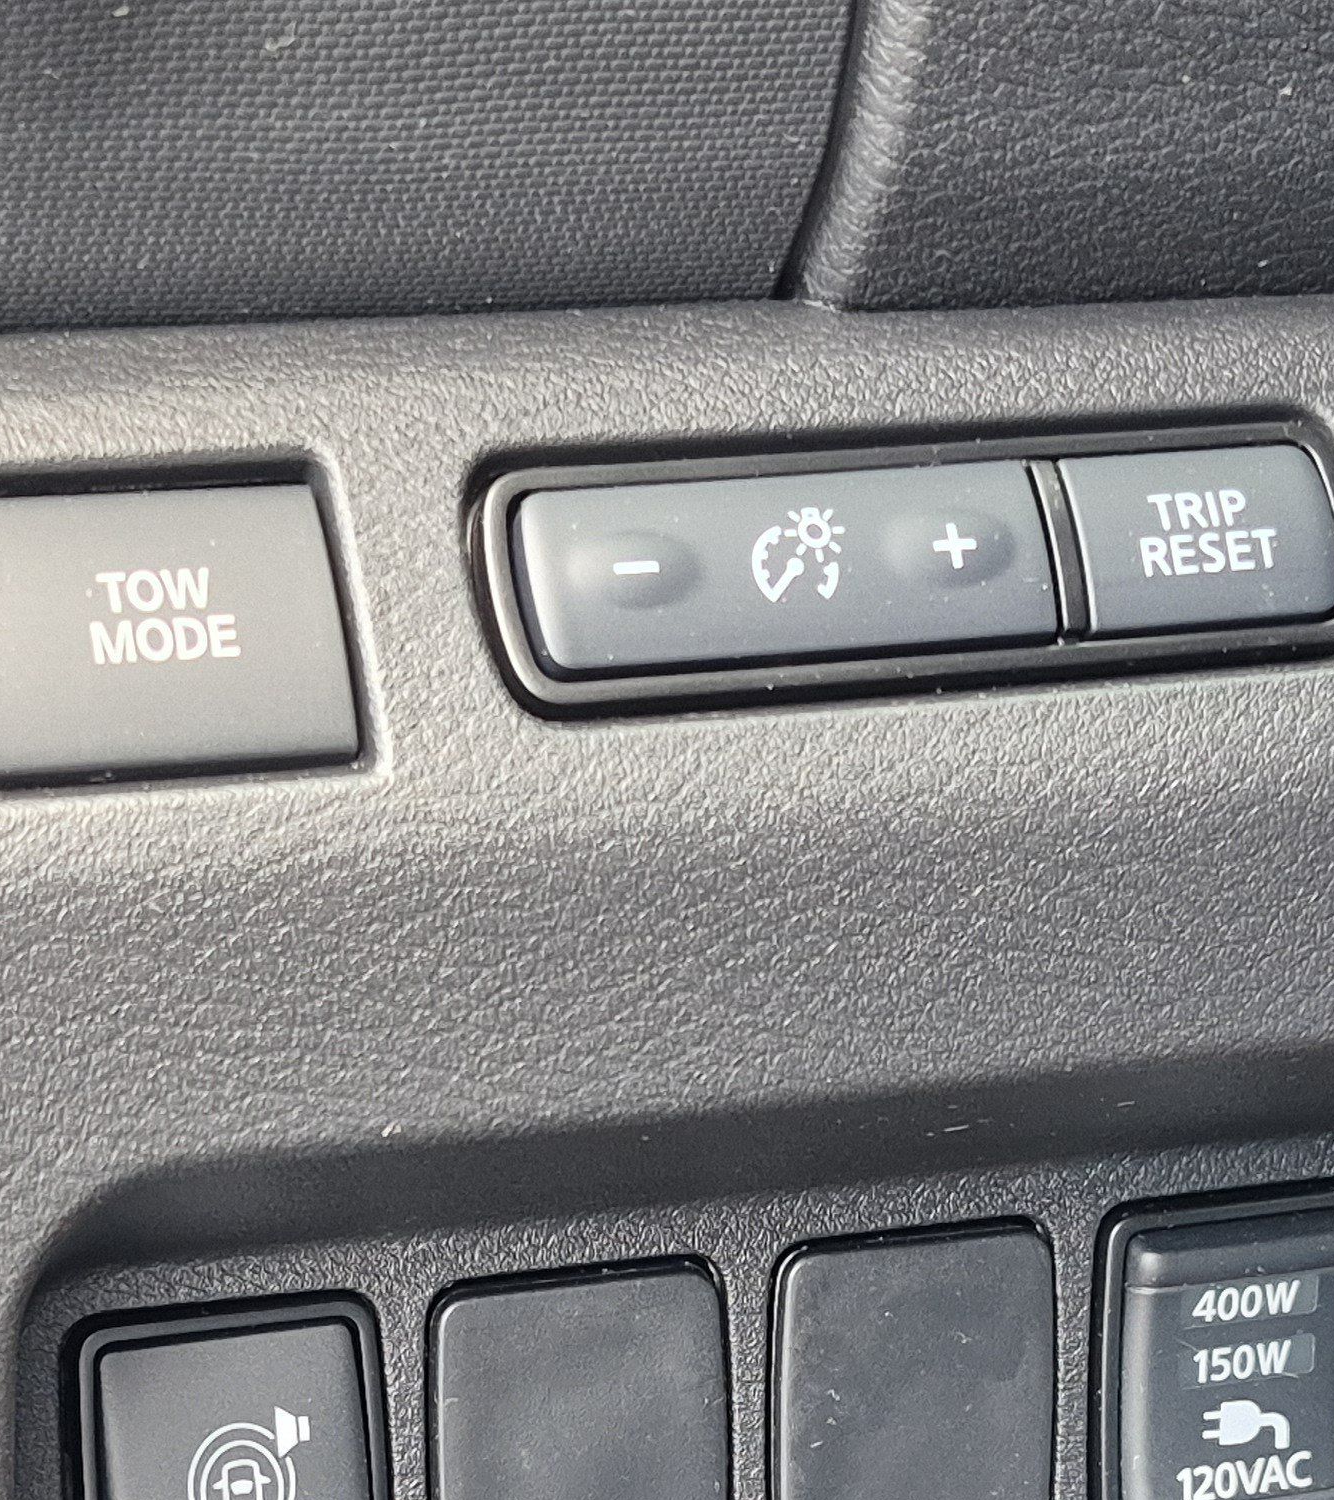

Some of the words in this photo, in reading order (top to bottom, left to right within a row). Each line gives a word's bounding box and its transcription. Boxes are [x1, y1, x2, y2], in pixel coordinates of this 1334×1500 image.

[1147, 490, 1248, 528] TRIP
[1139, 529, 1278, 577] RESET
[95, 567, 209, 613] TOW
[89, 614, 241, 664] MODE
[1191, 1280, 1301, 1322] 400W
[1192, 1340, 1292, 1383] 150W
